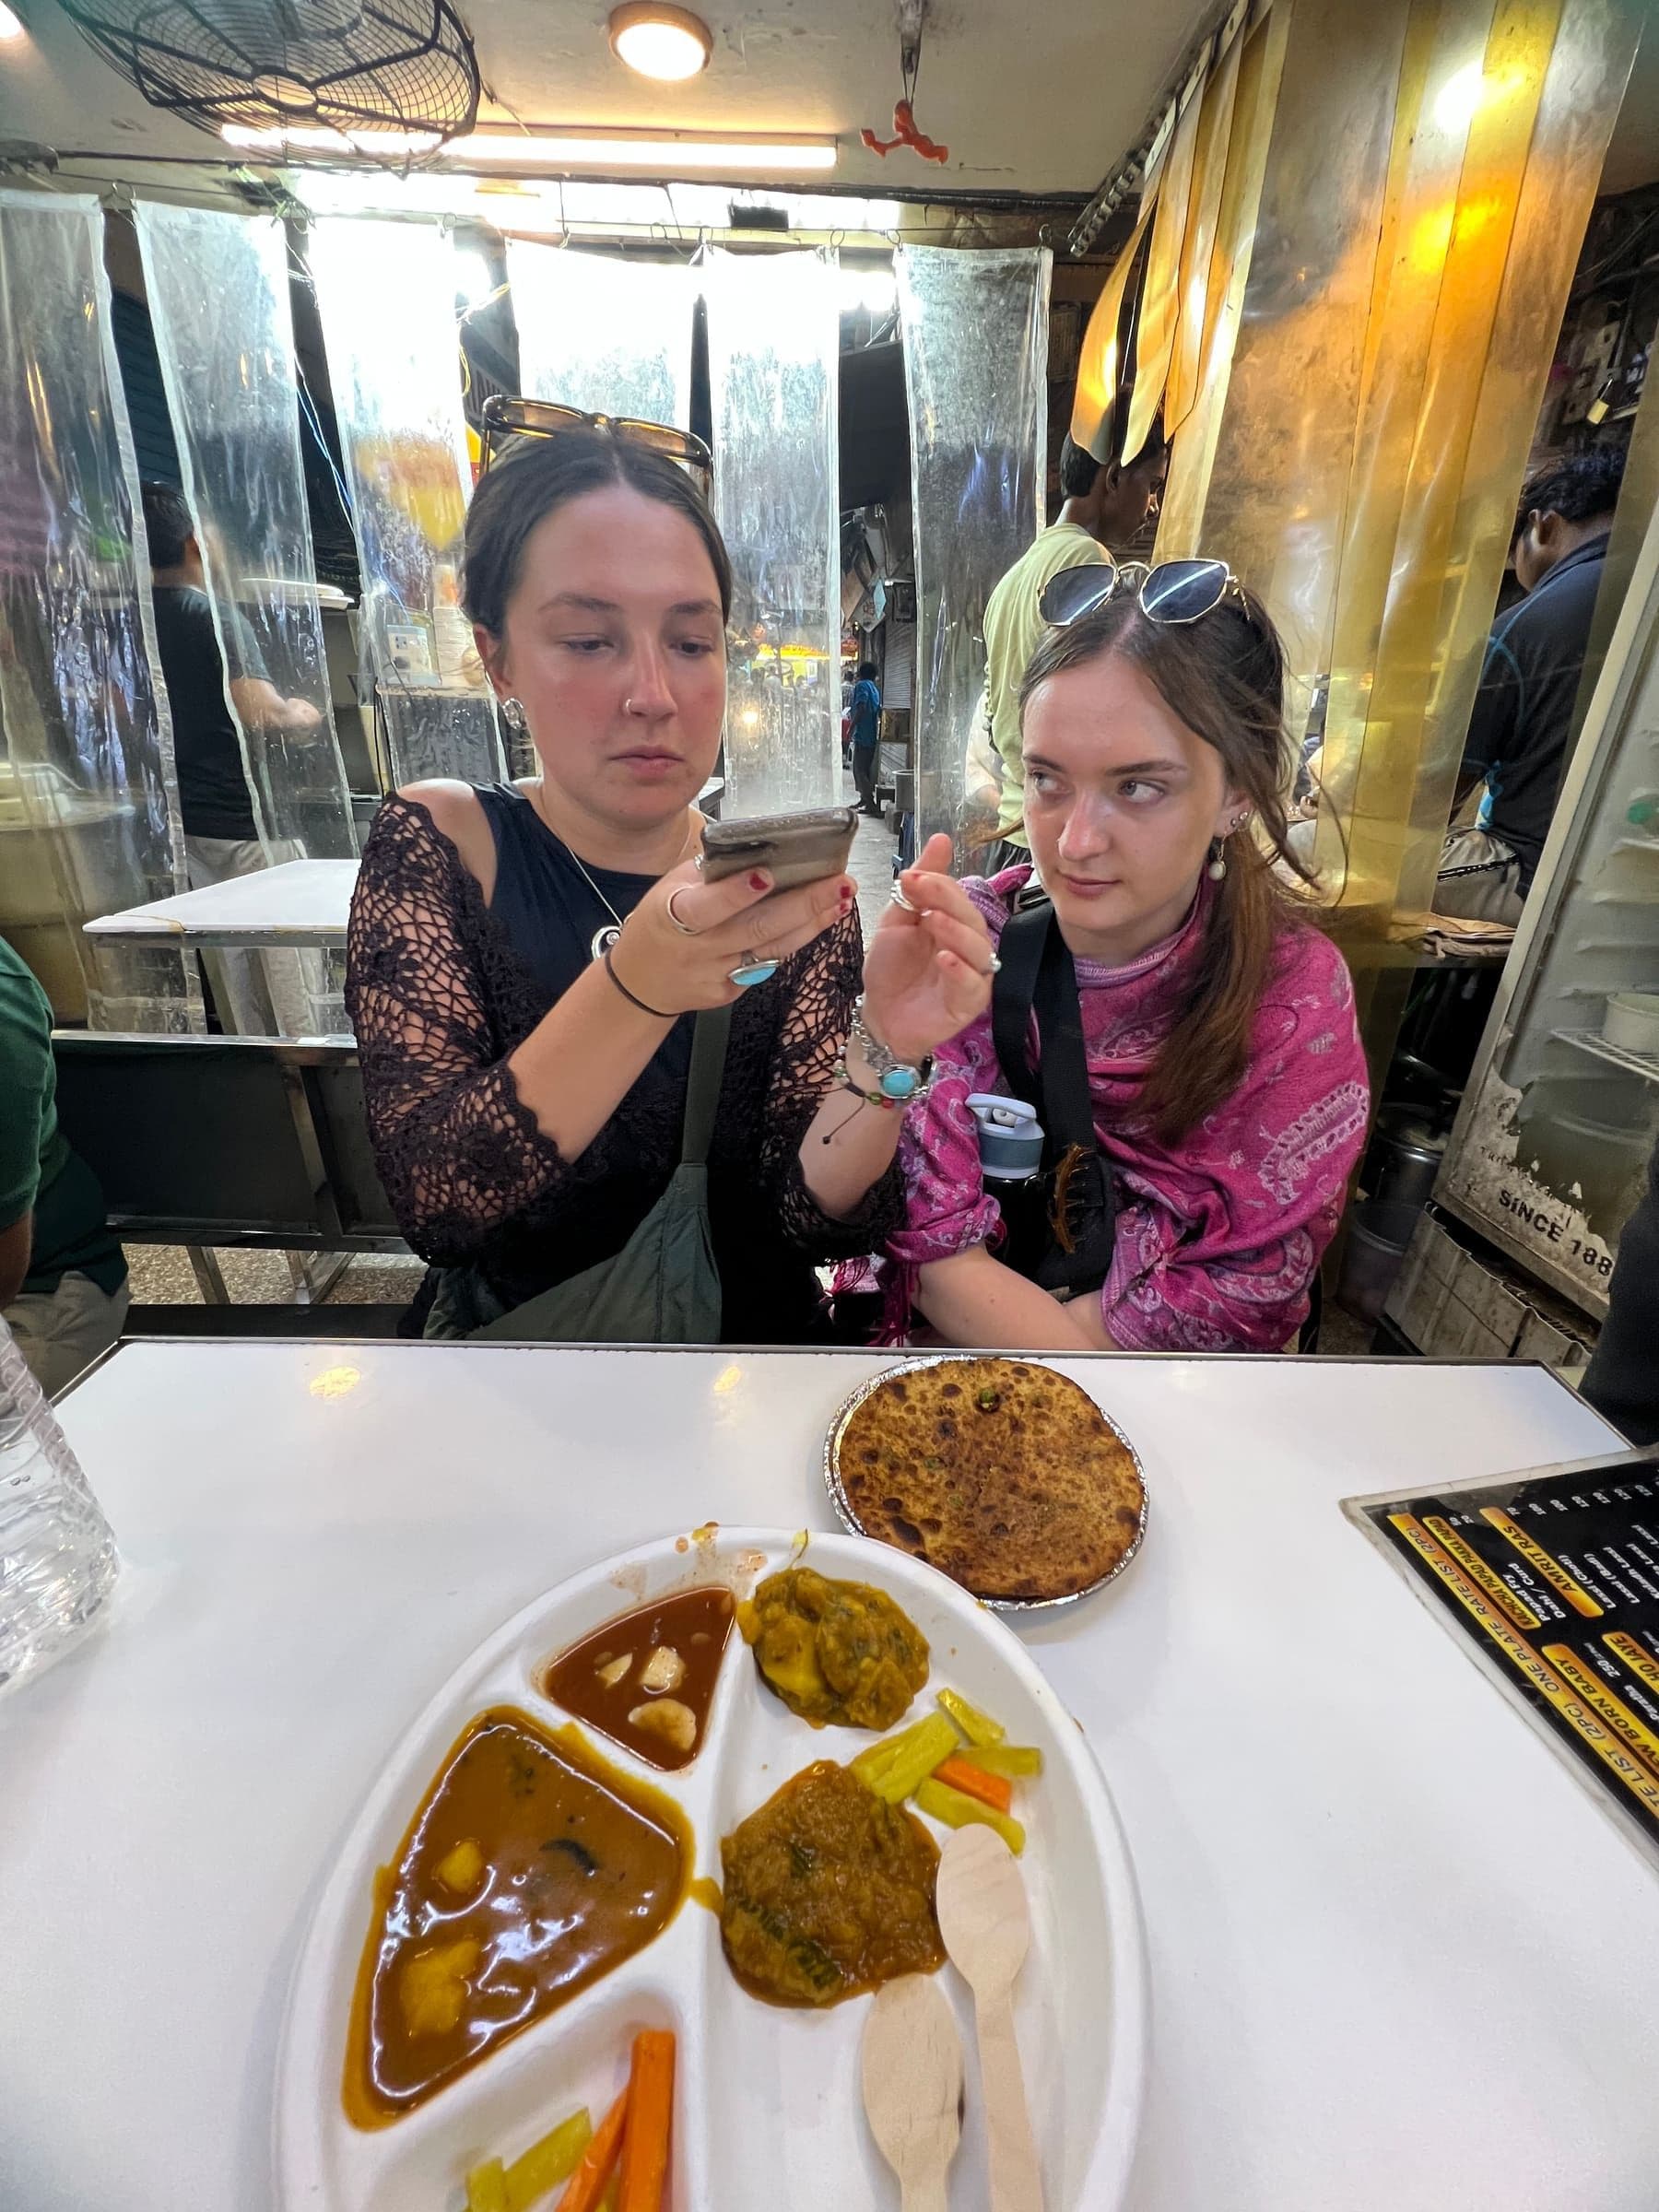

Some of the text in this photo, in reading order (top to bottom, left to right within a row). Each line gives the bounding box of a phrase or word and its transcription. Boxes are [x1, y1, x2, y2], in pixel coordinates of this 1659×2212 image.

[1571, 1239, 1613, 1277] 188
[1406, 1526, 1437, 1554] (2PC)
[1626, 1543, 1654, 1565] Lassi
[1432, 1559, 1462, 1583] LIST
[1503, 1525, 1578, 1593] AMRIT RAS
[1603, 1547, 1630, 1568] Lassi
[1471, 1565, 1500, 1588] PAPAD
[1502, 1574, 1521, 1589] Fry
[1508, 1563, 1535, 1585] Curd
[1456, 1584, 1489, 1616] RATE
[1516, 1590, 1551, 1621] Papad
[1538, 1594, 1567, 1618] Dahi
[1586, 1585, 1617, 1608] Lassi
[1610, 1581, 1641, 1604] Lassi
[1489, 1621, 1532, 1661] PLATE
[1609, 1636, 1646, 1662] JAYE
[1527, 1663, 1559, 1692] ONE
[1555, 1658, 1597, 1694] BABY
[1563, 1702, 1606, 1740] (2PC)
[1593, 1698, 1641, 1740] BORN
[1604, 1749, 1645, 1782] LIST
